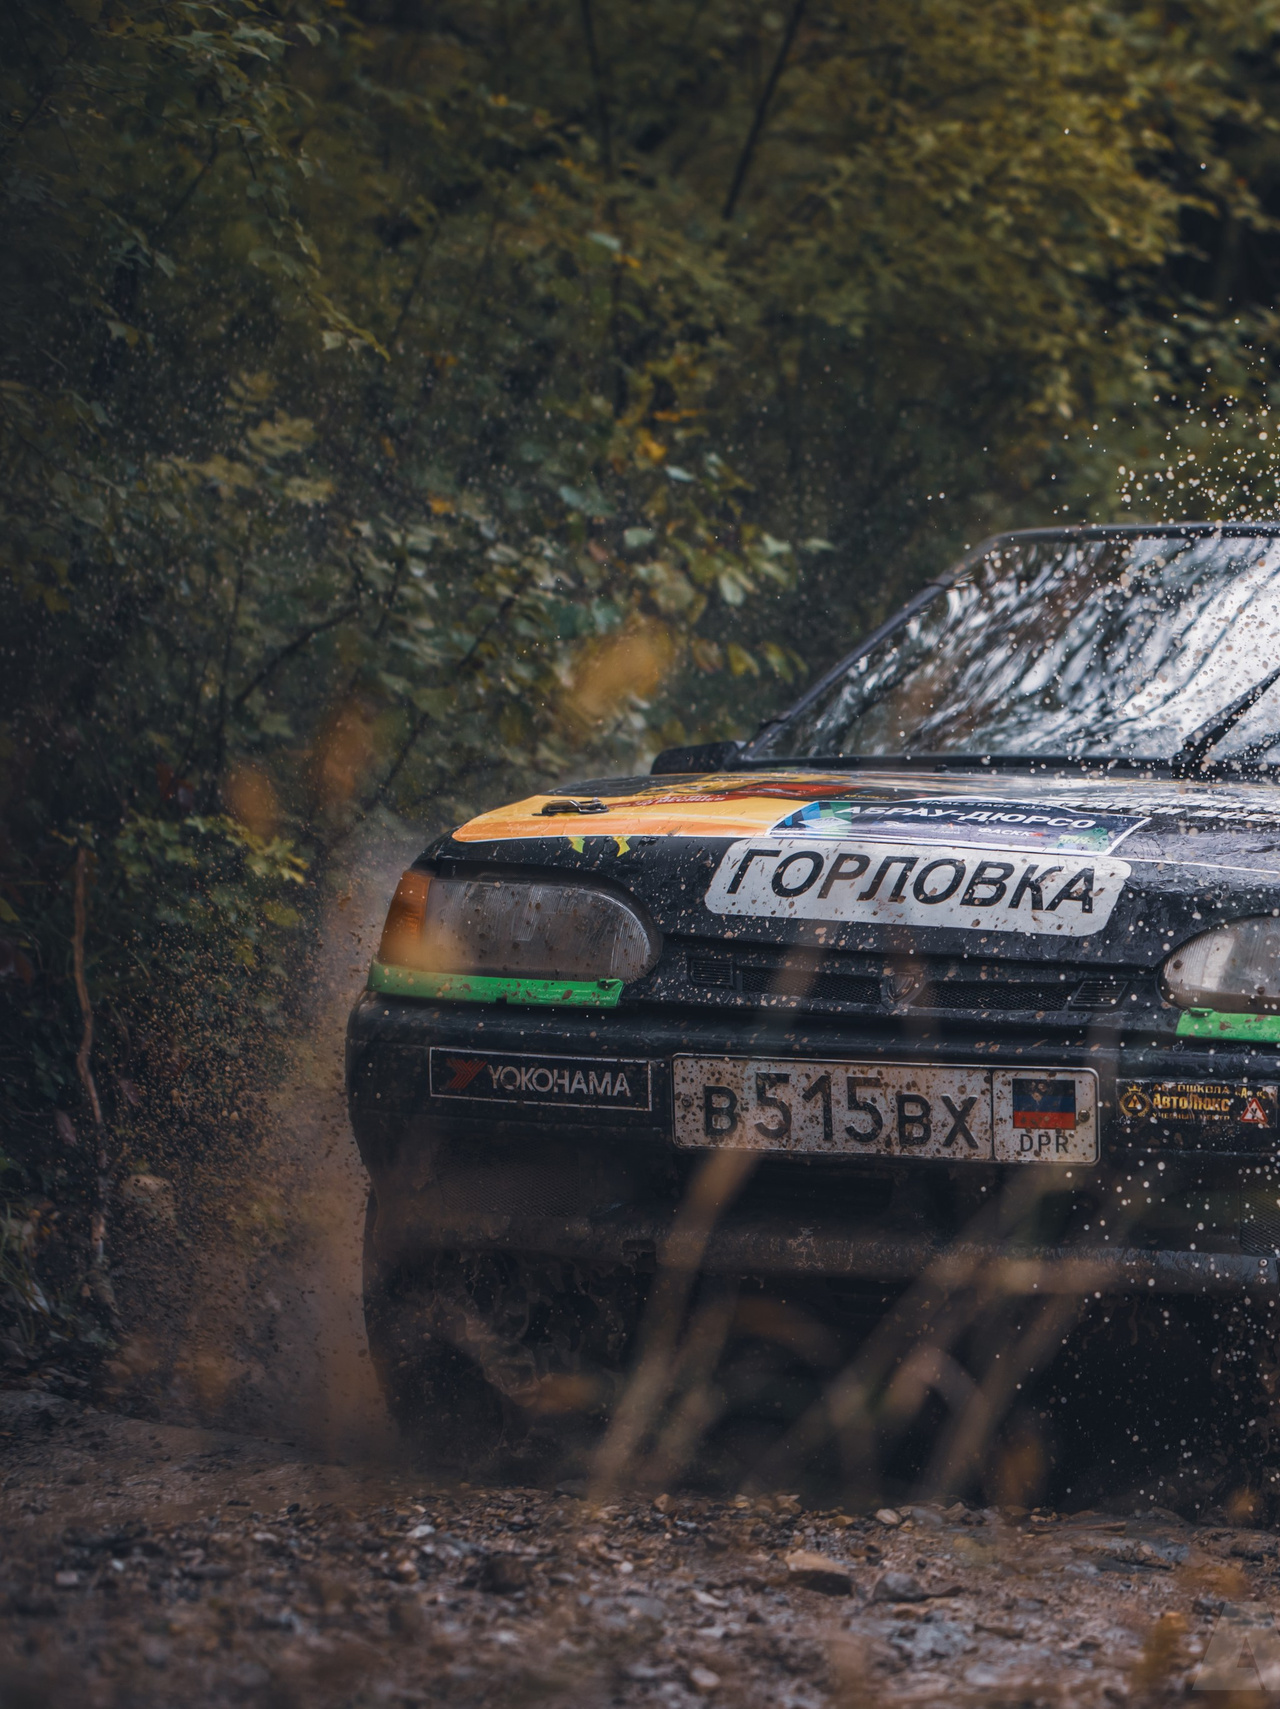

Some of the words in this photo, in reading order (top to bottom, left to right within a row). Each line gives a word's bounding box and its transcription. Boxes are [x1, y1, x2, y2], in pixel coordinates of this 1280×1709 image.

[836, 806, 1096, 829] АБРАУ-ДЮРСО
[727, 848, 1095, 914] ГОРЛОВКА
[487, 1064, 632, 1097] YOKOHAMA
[1020, 1134, 1069, 1154] DPR
